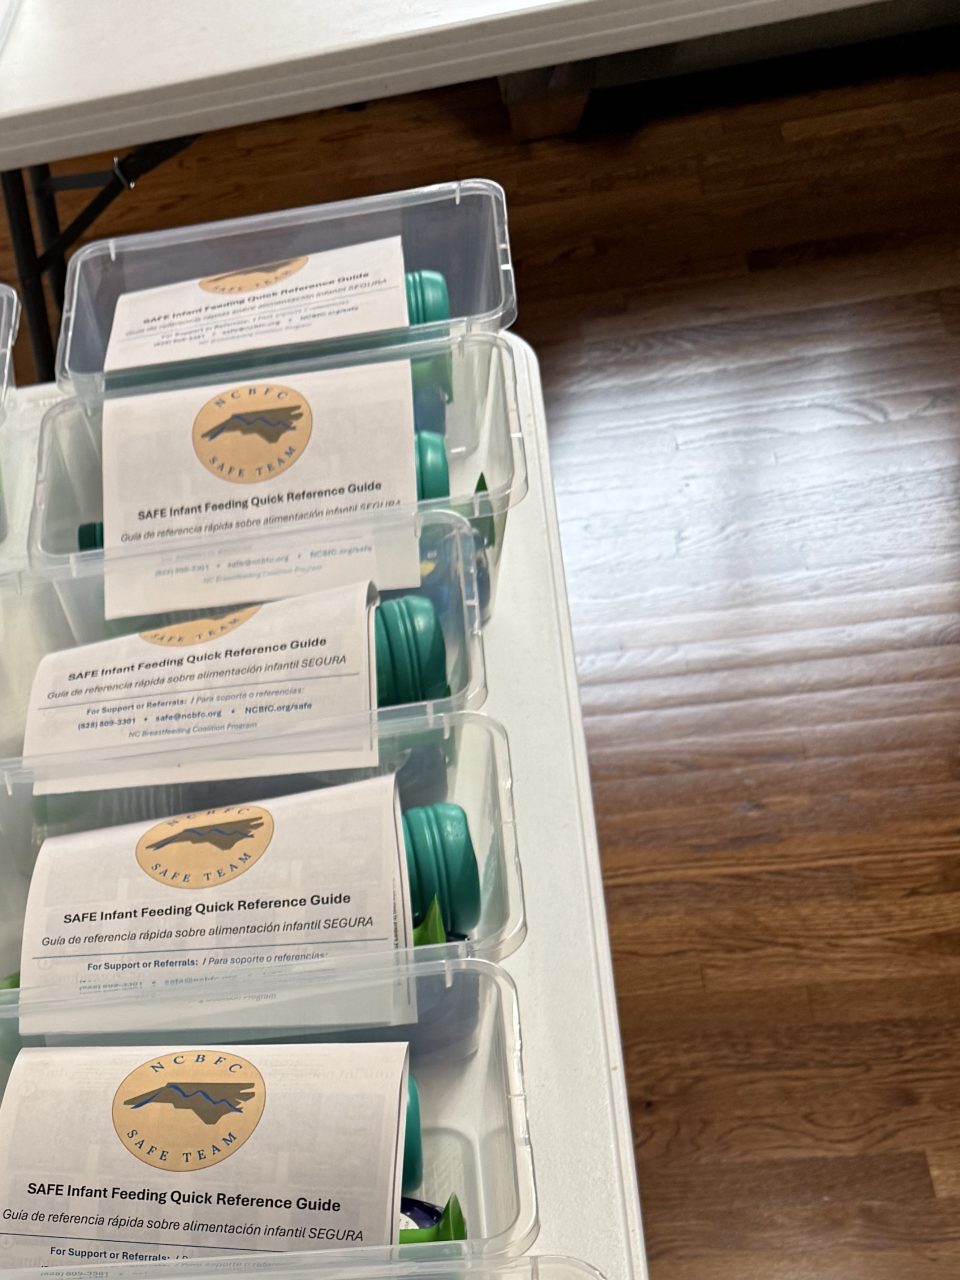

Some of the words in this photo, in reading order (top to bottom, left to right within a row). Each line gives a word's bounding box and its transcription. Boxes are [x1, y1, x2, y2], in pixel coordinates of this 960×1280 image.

[209, 456, 244, 477] SAFE
[256, 446, 296, 475] TEAM
[138, 508, 168, 520] SAFE
[170, 504, 202, 517] Infant
[204, 498, 248, 512] Feeding
[251, 494, 284, 507] Quick
[287, 488, 344, 502] Reference
[348, 481, 382, 494] Guide
[68, 670, 99, 681] SAFE
[101, 665, 135, 677] Infant
[138, 657, 183, 671] Feeding
[186, 650, 222, 665] Quick
[224, 643, 286, 658] Reference
[290, 637, 327, 649] Guide
[47, 690, 68, 700] Guía
[71, 688, 82, 697] de
[84, 682, 132, 696] referencia
[135, 677, 165, 690] rápida
[167, 674, 195, 684] sobre
[197, 666, 262, 681] alimentación
[264, 661, 299, 672] infantil
[301, 655, 346, 668] SEGURA
[151, 863, 191, 883] SAFE
[203, 852, 251, 882] TEAM
[64, 912, 97, 923] SAFE
[100, 909, 138, 921] Infant
[141, 905, 192, 917] Feeding
[195, 901, 233, 914] Quick
[238, 897, 306, 910] Reference
[311, 893, 351, 905] Guide
[42, 936, 65, 946] Guía
[68, 935, 81, 945] de
[83, 931, 136, 944] referencia
[139, 929, 172, 941] rápida
[175, 927, 205, 938] sobre
[209, 922, 280, 936] alimentación
[283, 921, 321, 932] infantil
[323, 917, 373, 929] SEGURA
[88, 963, 101, 971] For
[104, 961, 140, 971] Support
[154, 958, 198, 968] Referrals:
[150, 1054, 242, 1073] NCBFC
[127, 1129, 168, 1161] SAFE
[183, 1132, 237, 1162] TEAM
[27, 1183, 64, 1195] SAFE
[67, 1185, 108, 1198] Infant
[111, 1188, 167, 1204] Feeding
[170, 1190, 212, 1205] Quick
[216, 1193, 291, 1209] Reference
[296, 1197, 341, 1212] Guide
[3, 1209, 27, 1220] Guía
[31, 1211, 45, 1221] de
[48, 1212, 104, 1225] referencia
[108, 1215, 143, 1228] rápida
[147, 1218, 180, 1230] sobre
[183, 1220, 261, 1235] alimentación
[264, 1224, 305, 1238] infantil
[308, 1228, 363, 1241] SEGURA
[50, 1247, 66, 1255] For
[68, 1248, 107, 1259] Support
[122, 1251, 170, 1261] Referrals:
